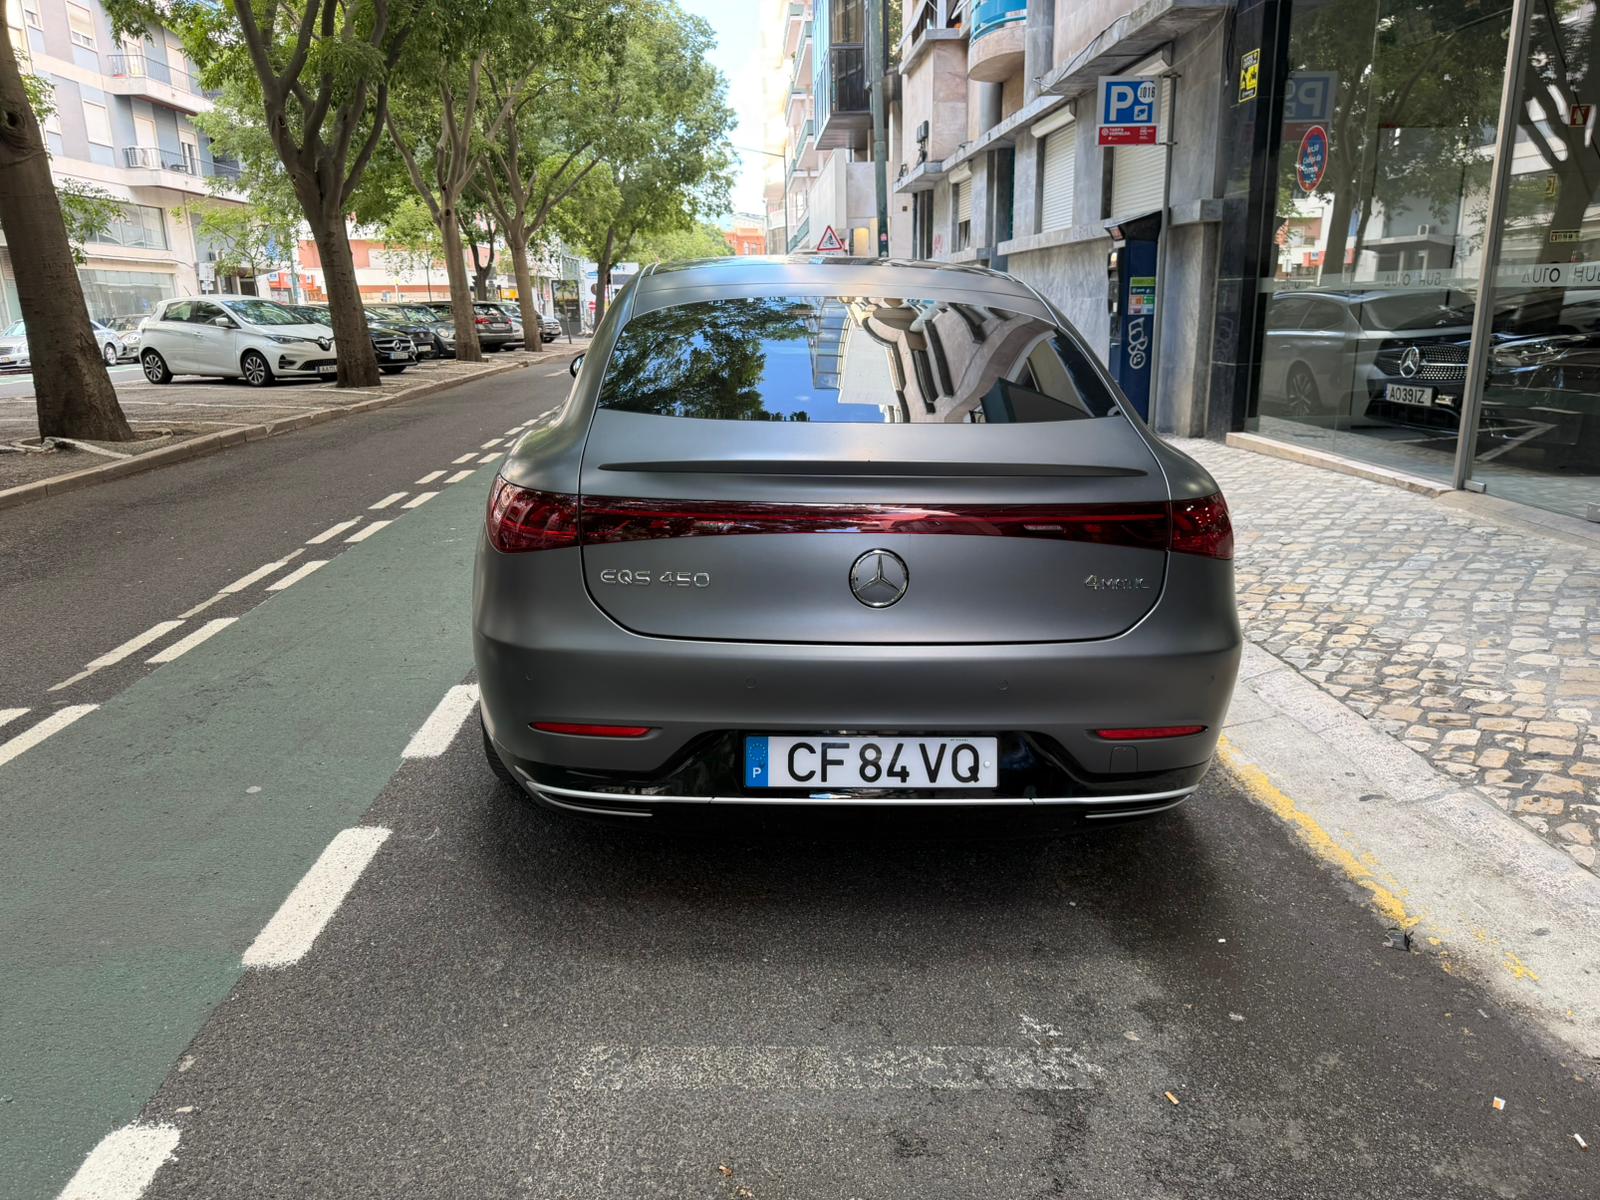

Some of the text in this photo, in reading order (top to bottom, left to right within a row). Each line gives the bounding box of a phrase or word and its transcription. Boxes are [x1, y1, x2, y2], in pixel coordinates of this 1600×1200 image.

[1109, 85, 1135, 121] P
[1574, 265, 1600, 282] HU
[600, 569, 710, 587] EQS 450
[787, 742, 980, 783] CF 84 VQ
[752, 767, 762, 779] P
